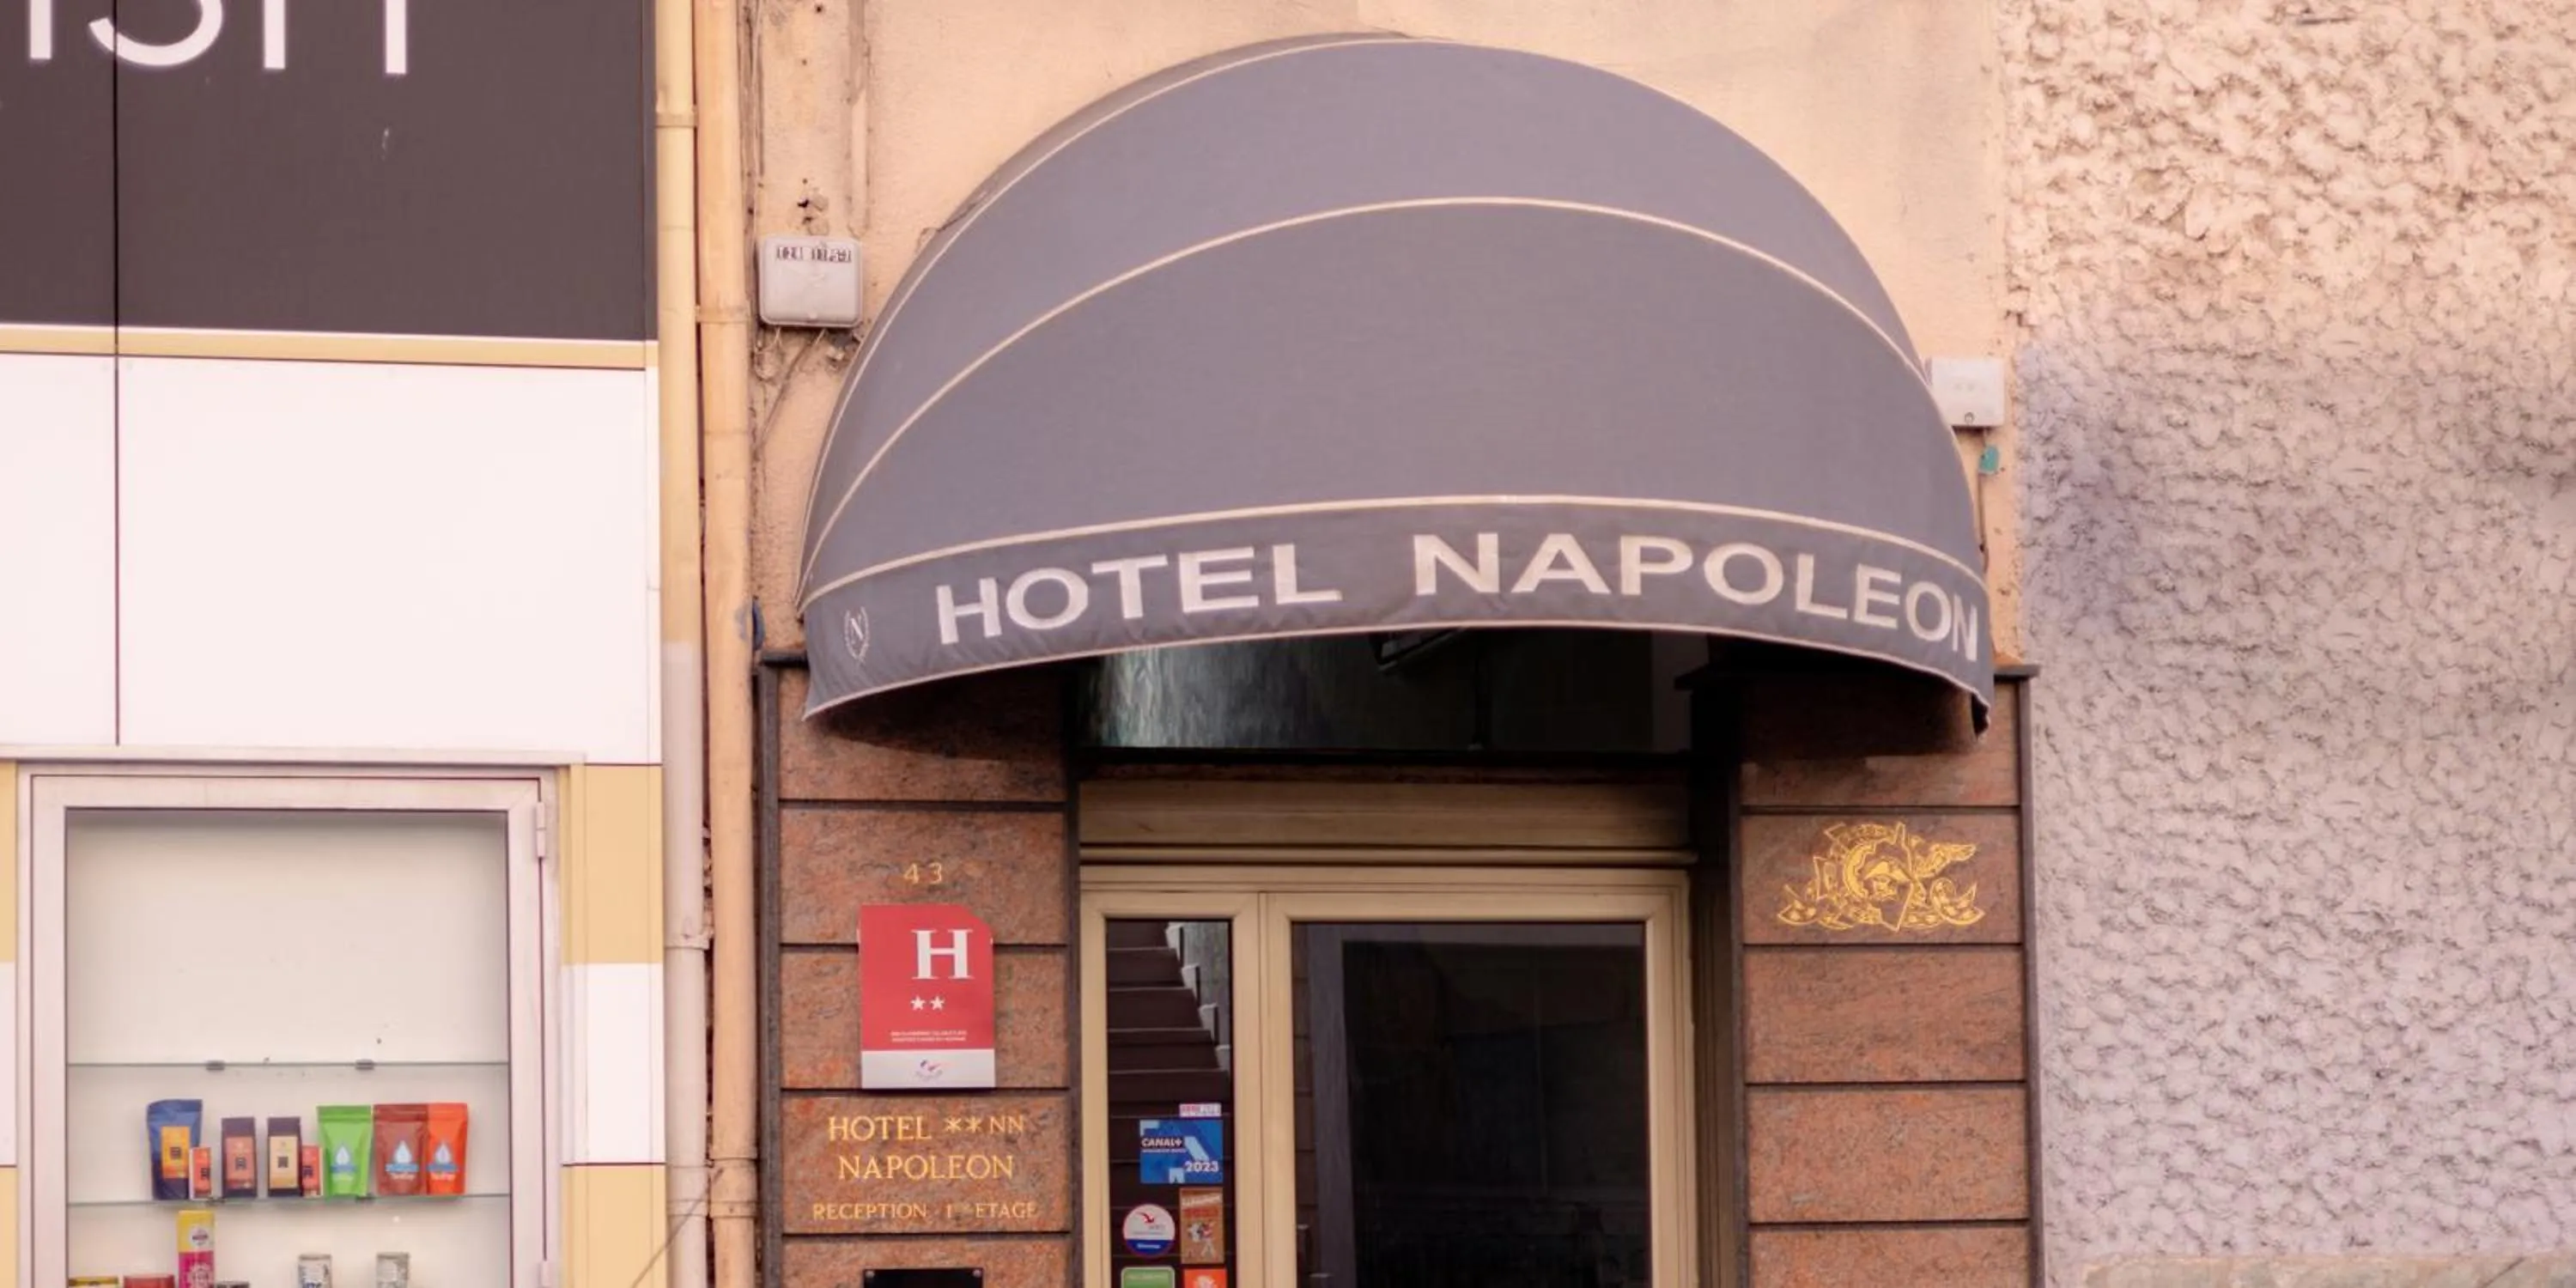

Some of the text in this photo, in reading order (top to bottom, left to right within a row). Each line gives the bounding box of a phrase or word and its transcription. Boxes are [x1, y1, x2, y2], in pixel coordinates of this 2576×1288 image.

[936, 532, 1978, 662] HOTEL NAPOLEON
[903, 862, 943, 884] 43
[910, 928, 974, 981] H
[828, 1115, 933, 1142] HOTEL
[1141, 1138, 1182, 1147] CANAL+
[838, 1155, 1014, 1180] NAPOLEON
[1185, 1160, 1219, 1173] 2023
[812, 1203, 927, 1220] RECEPTION
[975, 1202, 1039, 1219] ETAGE
